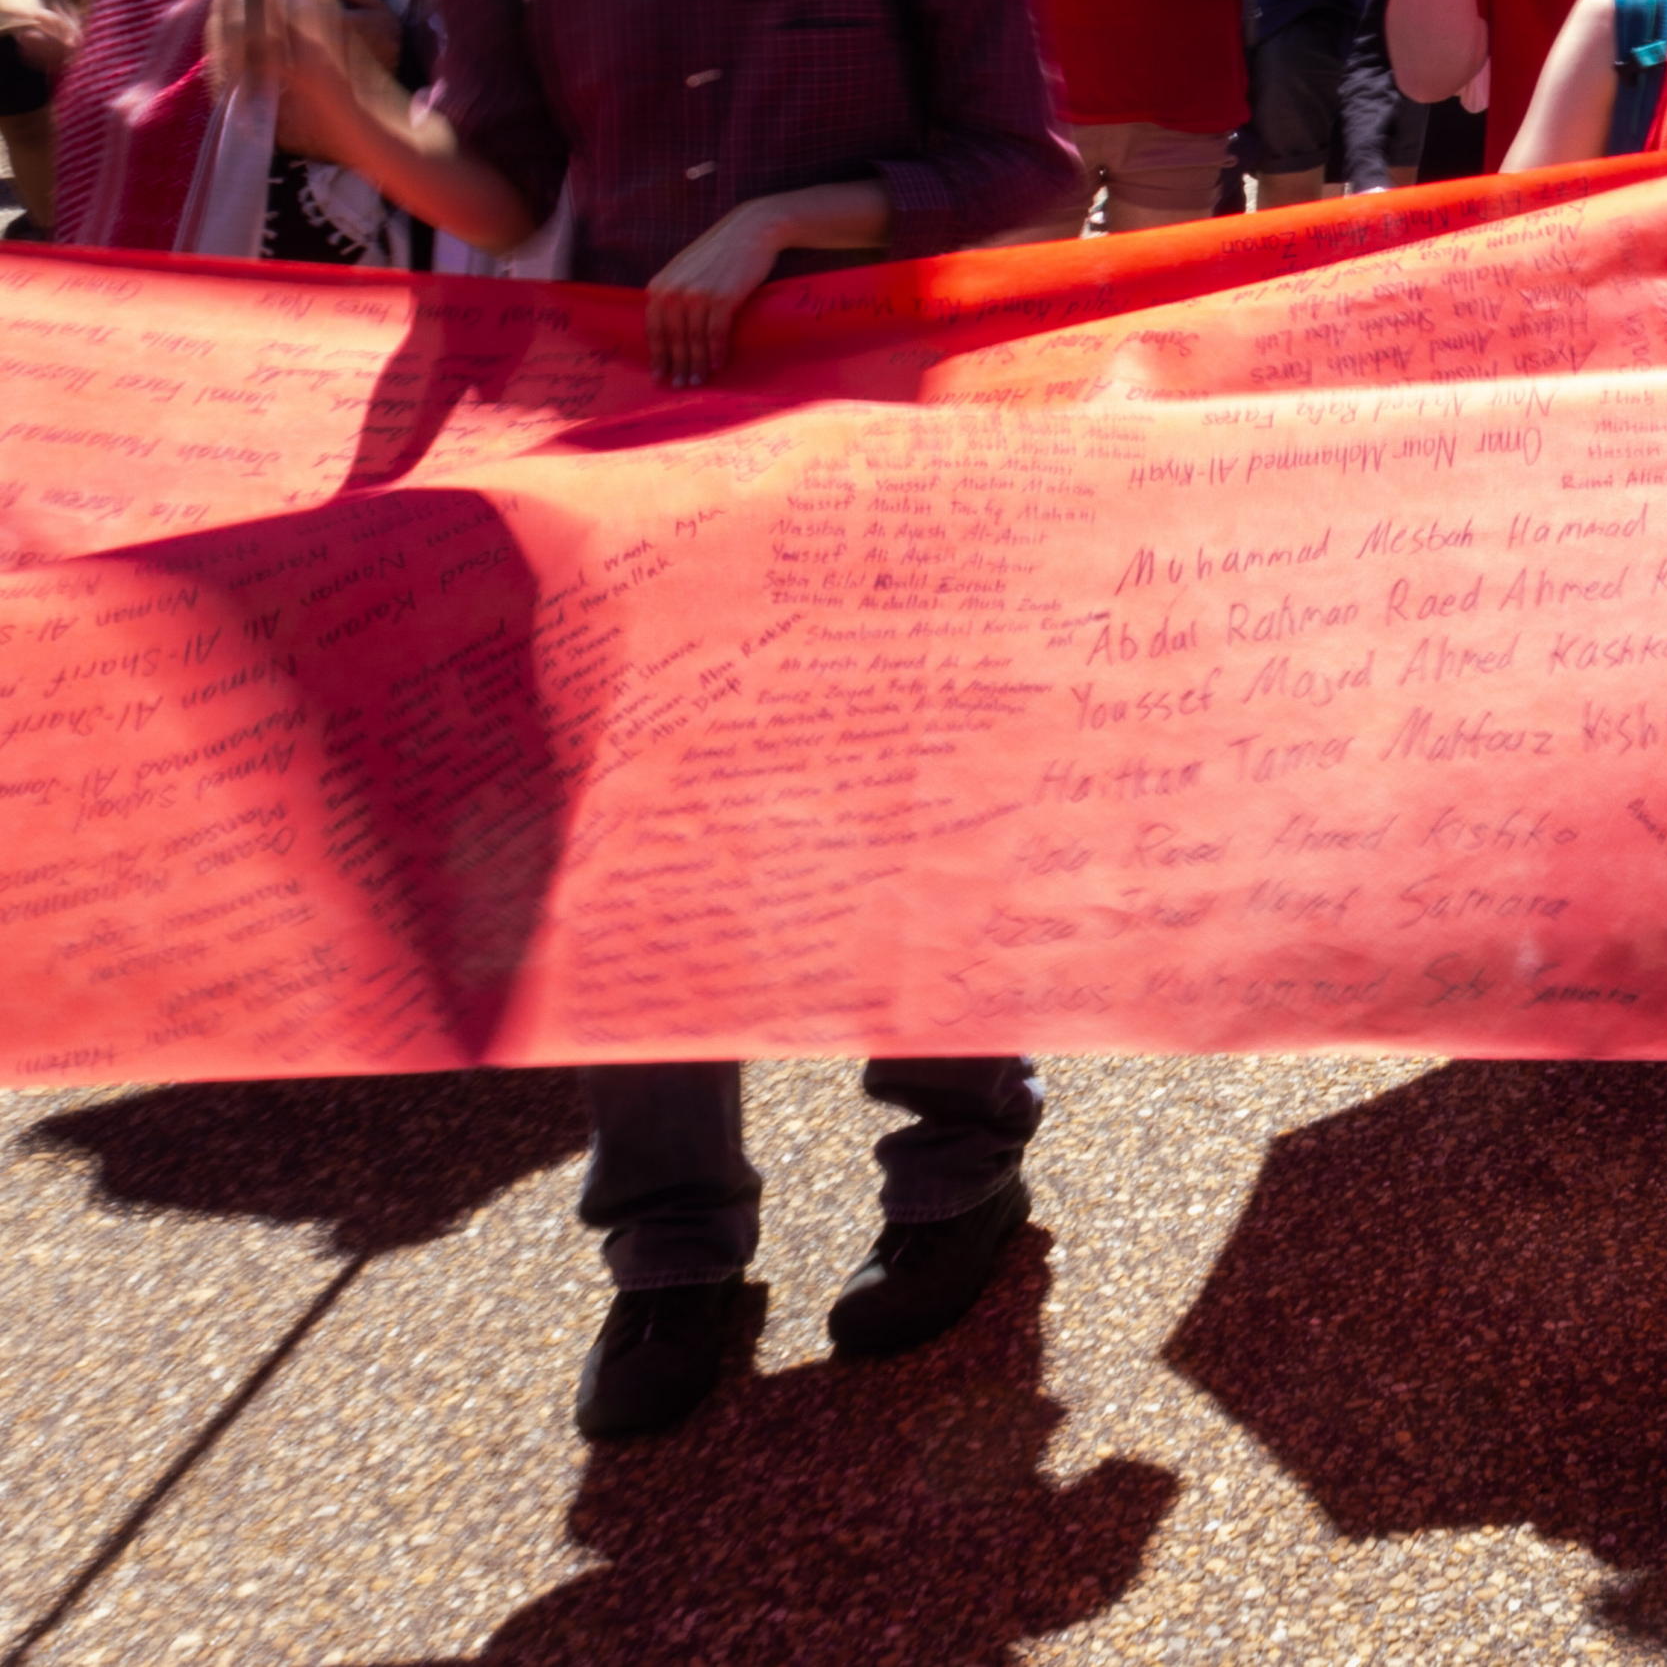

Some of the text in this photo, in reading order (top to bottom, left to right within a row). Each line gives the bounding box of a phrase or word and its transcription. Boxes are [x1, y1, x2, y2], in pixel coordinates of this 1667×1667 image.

[1246, 441, 1387, 484] Mohammed
[1392, 431, 1457, 471] Nour
[1473, 426, 1542, 467] Omar
[1115, 525, 1332, 596] Muhammad
[1385, 567, 1485, 629] Raed
[1498, 561, 1627, 612] Ahmed
[1069, 667, 1222, 731] Youssef
[1398, 633, 1520, 687] Ahmed
